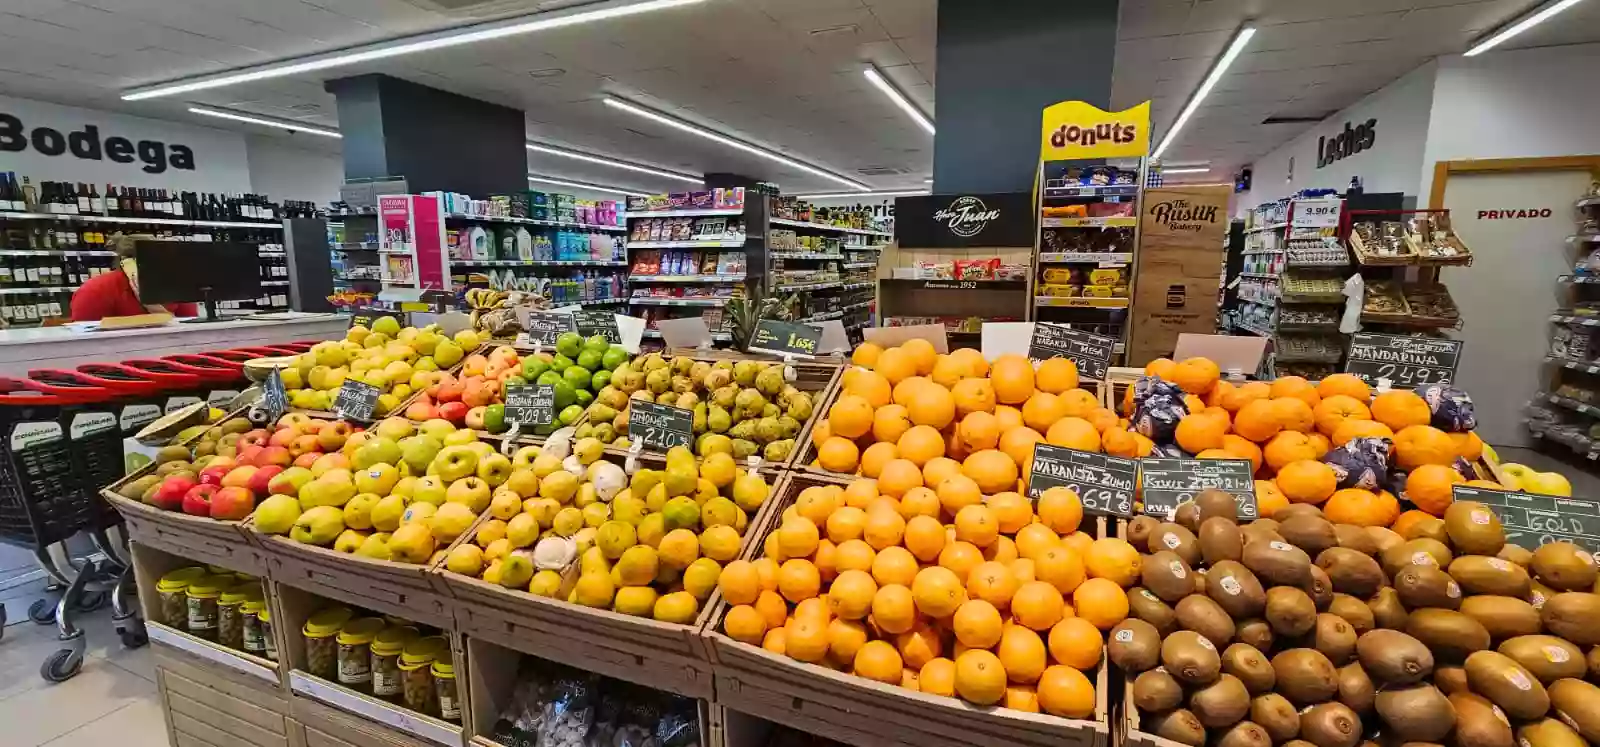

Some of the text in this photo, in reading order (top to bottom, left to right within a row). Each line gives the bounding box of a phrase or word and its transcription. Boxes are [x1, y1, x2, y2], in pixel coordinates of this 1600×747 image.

[0, 113, 195, 174] Bodega
[1051, 123, 1136, 148] donuts
[1316, 118, 1377, 169] Leches
[948, 205, 1001, 228] Juan
[1305, 206, 1337, 215] 9.90 €
[1477, 208, 1553, 220] PRIVADO
[960, 281, 977, 289] 1952
[1036, 337, 1103, 357] NARANJA MESA
[1351, 347, 1439, 365] MANDARINA
[1032, 460, 1132, 490] NARANJA ZUMO
[1530, 516, 1583, 534] GOLD
